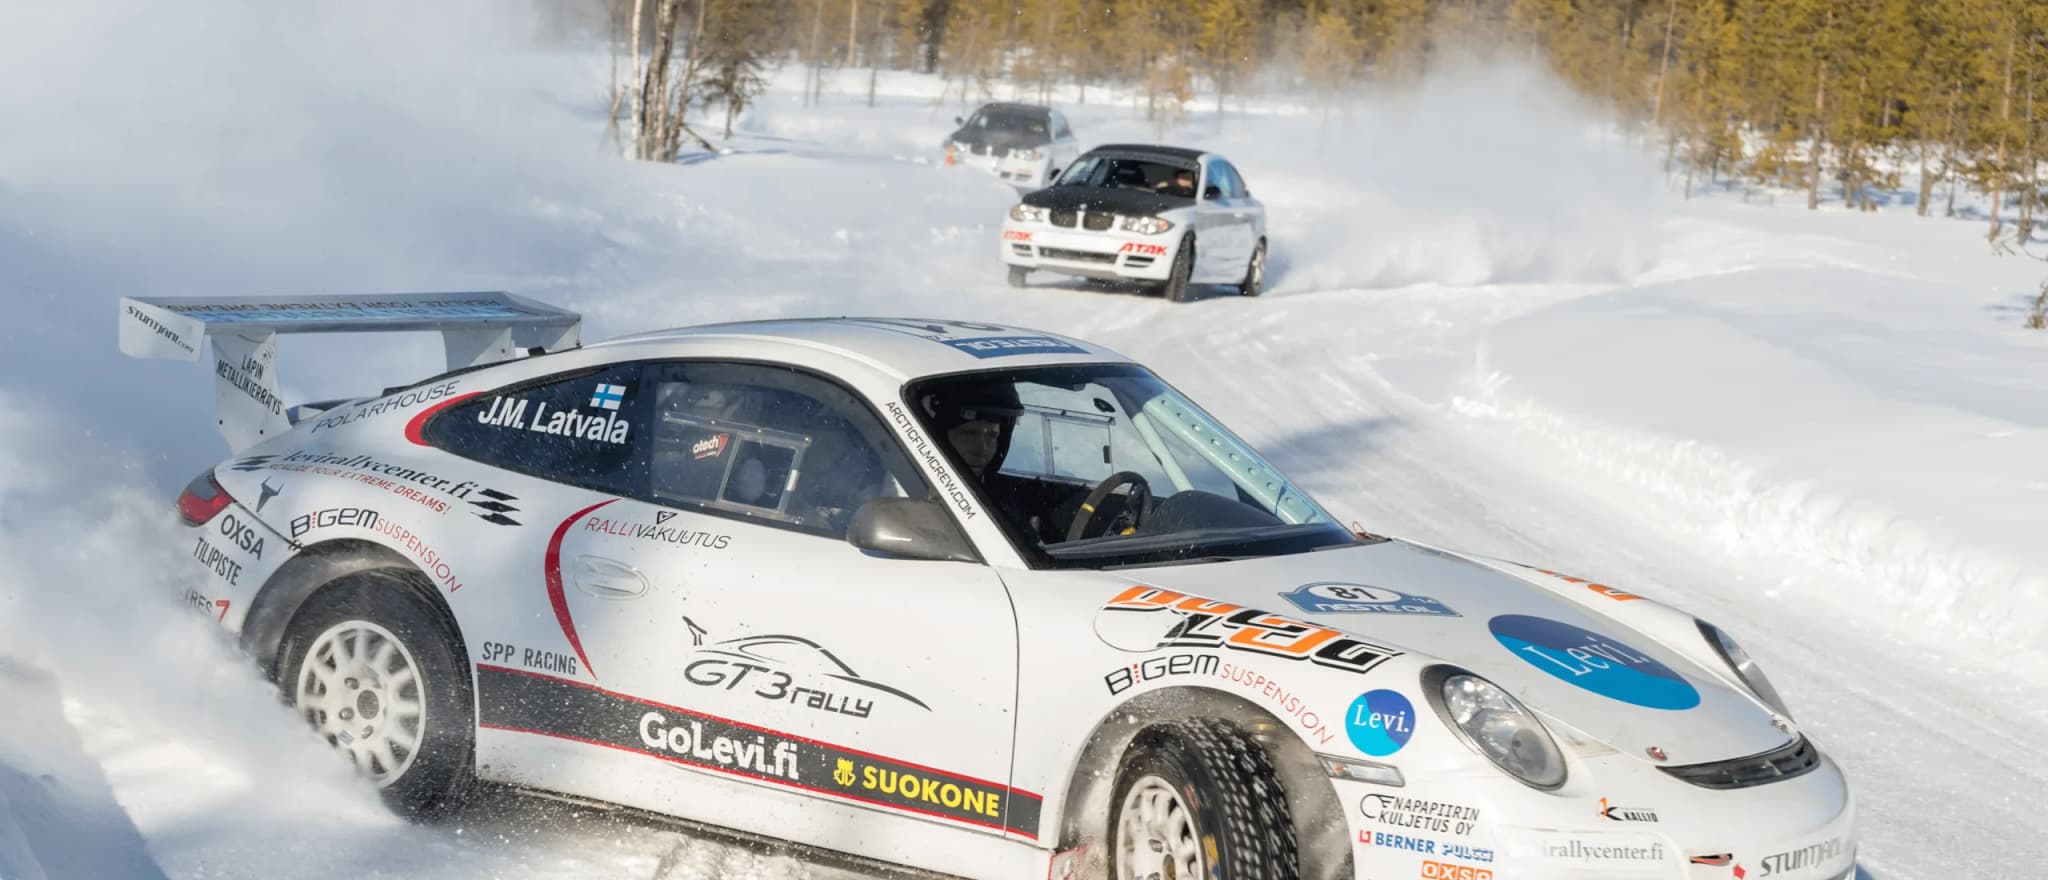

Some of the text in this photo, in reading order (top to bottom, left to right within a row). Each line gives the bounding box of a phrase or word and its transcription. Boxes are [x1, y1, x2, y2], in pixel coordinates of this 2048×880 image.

[1118, 242, 1168, 256] ATAK
[241, 354, 264, 380] LAPIN
[312, 380, 461, 434] POLARHOUSE
[477, 396, 630, 445] J.M. Latvala
[283, 450, 477, 500] levirallycenter.fi
[885, 401, 977, 520] ARCTICFILMCREW.COM
[312, 465, 338, 477] YOUR
[340, 470, 397, 490] EXTREME
[394, 485, 452, 515] DREAMS!
[221, 514, 265, 560] OXSA
[584, 516, 732, 551] RALLIVAKUUTUS
[193, 537, 243, 587] TILIPISTE
[375, 517, 463, 593] SUSPENSION
[1315, 603, 1397, 613] NESTE
[1327, 586, 1379, 600] 81
[482, 641, 577, 676] SPP RACING
[1521, 636, 1651, 676] Levi.
[1220, 663, 1335, 746] SUSPENSION
[1354, 703, 1410, 733] Levi.
[638, 711, 800, 780] GoLevi.fi
[862, 764, 1000, 817] SUOKONE
[1393, 797, 1481, 822] NAPAPIIRIN
[1378, 810, 1475, 836] KULJETUS OY
[1623, 812, 1659, 822] KALLIO
[1375, 832, 1436, 854] BERNER
